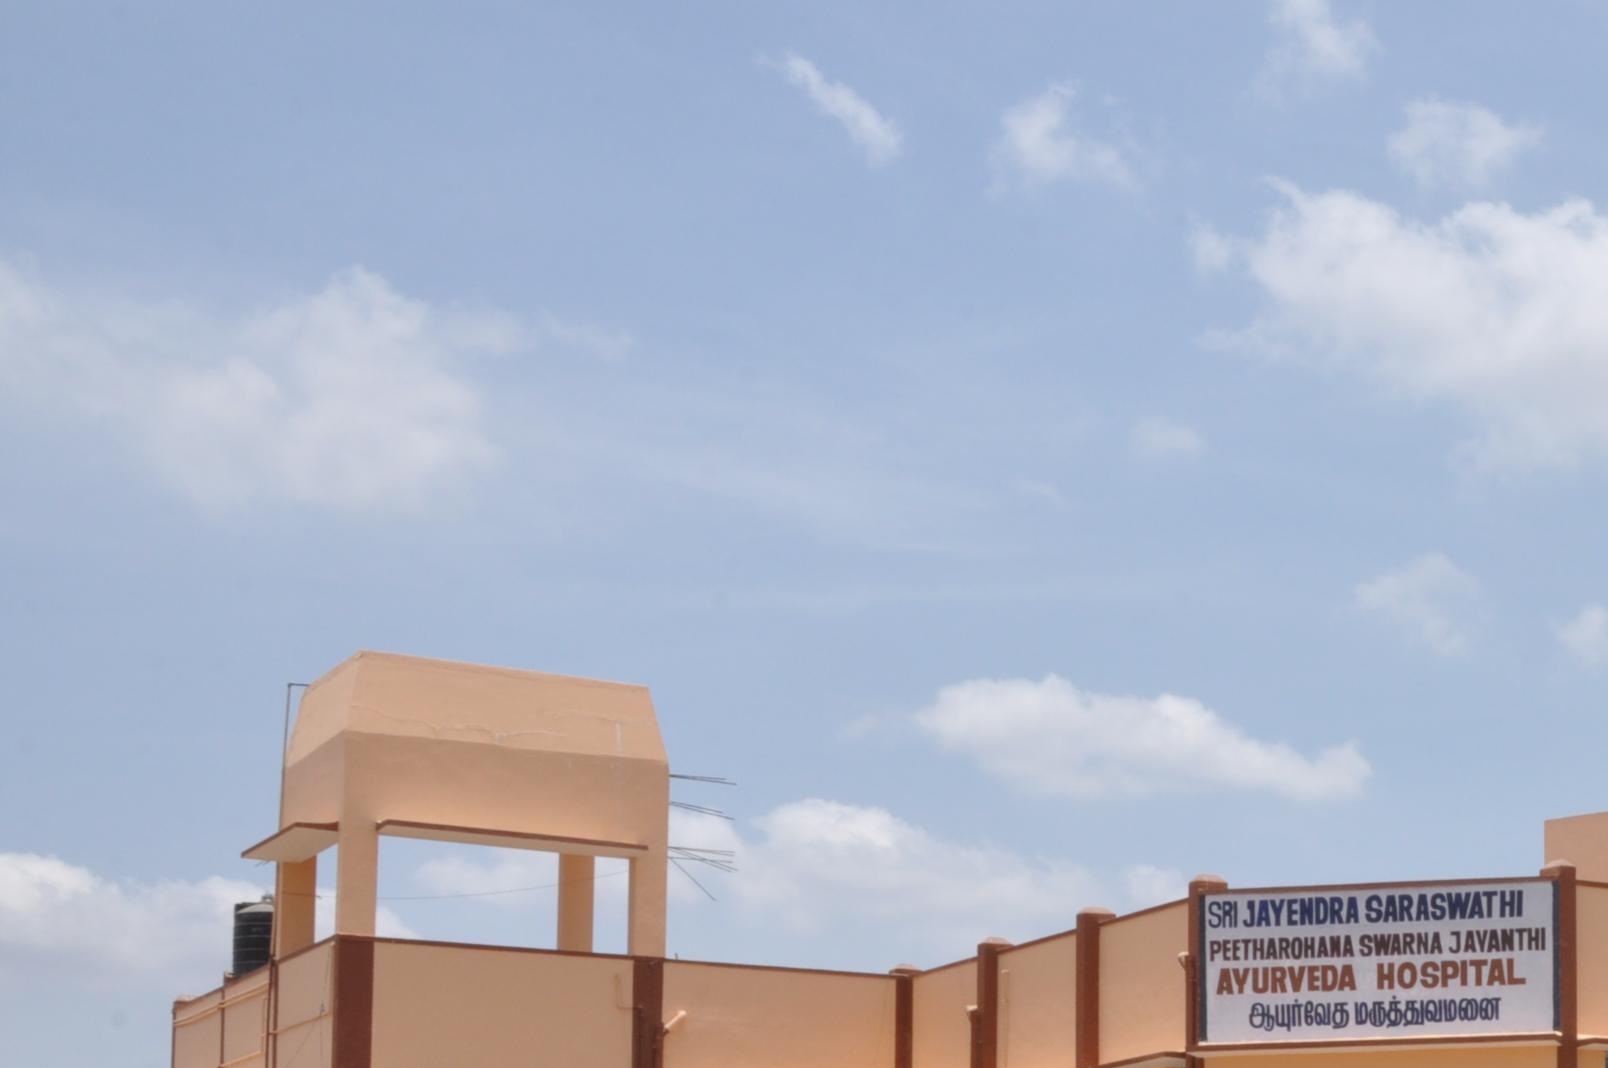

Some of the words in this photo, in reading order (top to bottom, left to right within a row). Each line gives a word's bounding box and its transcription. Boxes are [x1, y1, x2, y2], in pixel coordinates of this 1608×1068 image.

[1208, 900, 1238, 928] SRI
[1243, 896, 1359, 927] JAYENDRA
[1365, 890, 1524, 923] SARASWATHI
[1209, 935, 1354, 962] PEETHAROHANA
[1359, 931, 1443, 957] SWARNA
[1216, 964, 1357, 995] AYURVEDA
[1377, 958, 1527, 990] HOSPITAL
[1249, 999, 1350, 1032] ஆயுர்வேத
[1354, 995, 1502, 1028] மருத்துவமனை
